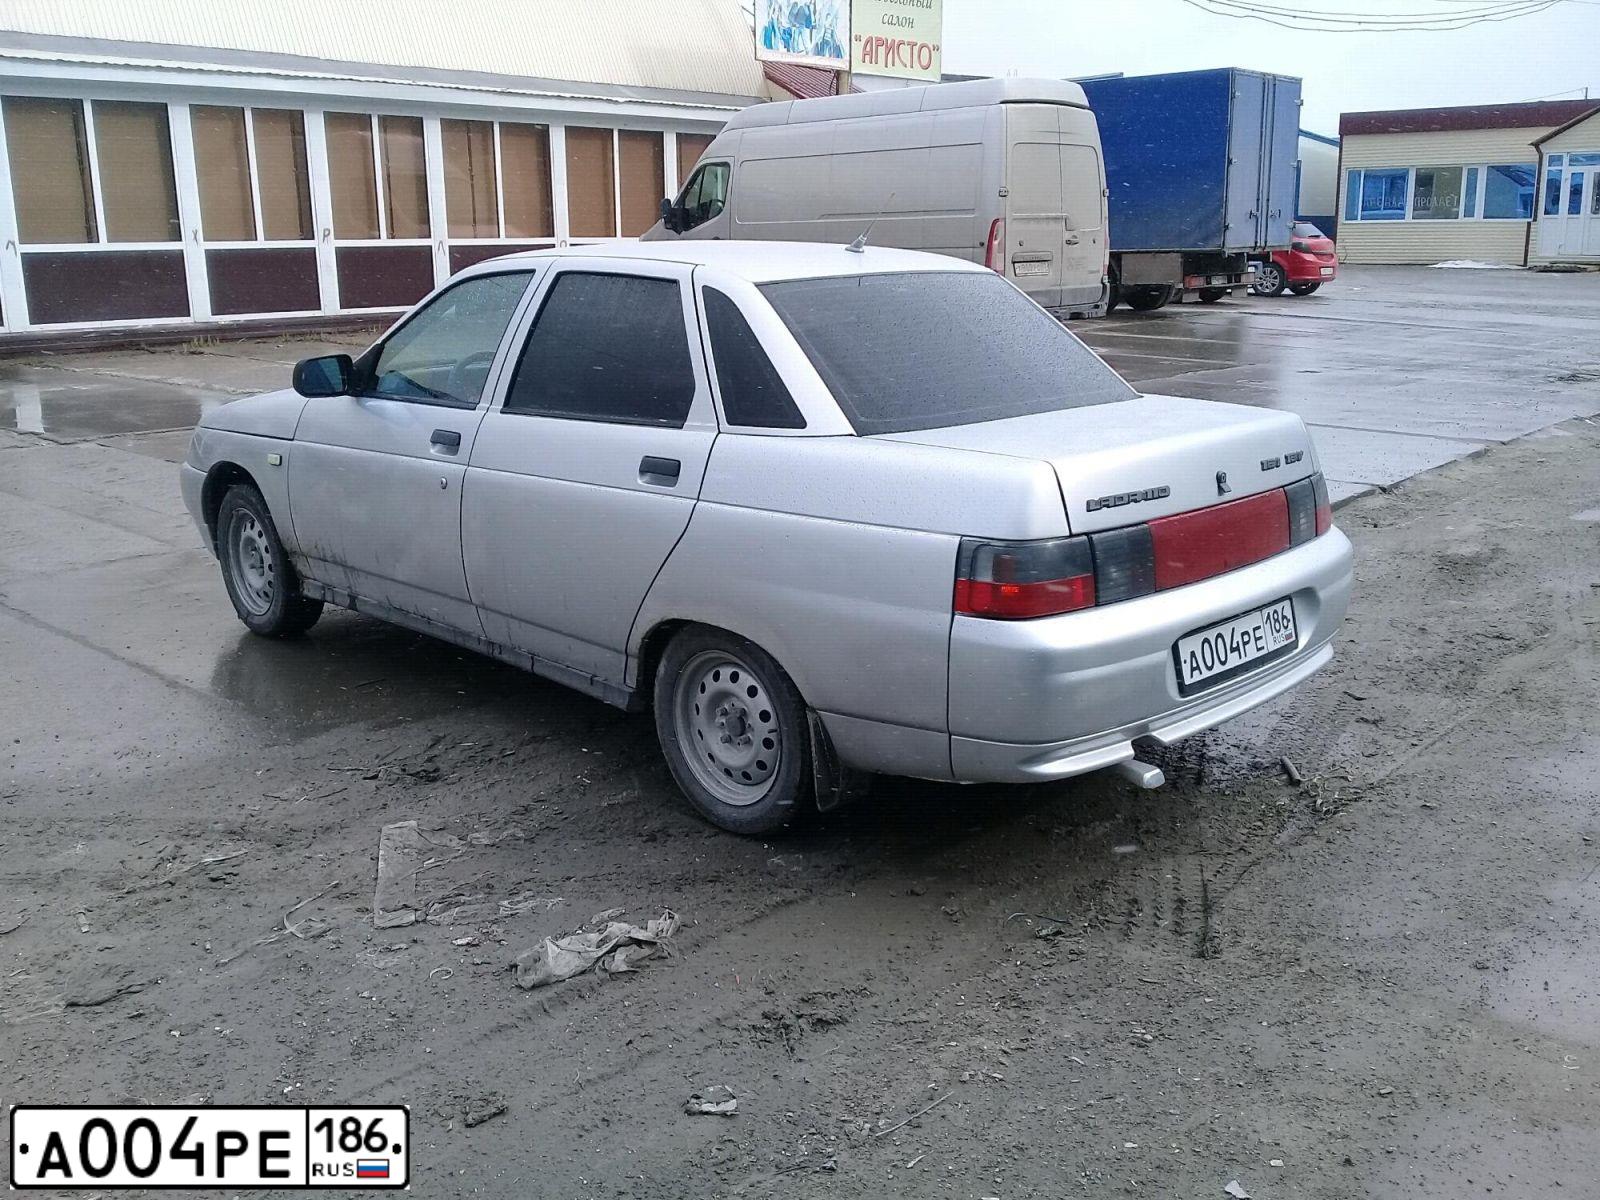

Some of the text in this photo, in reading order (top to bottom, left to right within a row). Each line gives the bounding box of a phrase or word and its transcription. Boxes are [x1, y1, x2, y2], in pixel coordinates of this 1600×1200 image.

[881, 13, 915, 28] салон
[1189, 605, 1290, 678] А004РЕ 186
[1273, 633, 1285, 646] RUS
